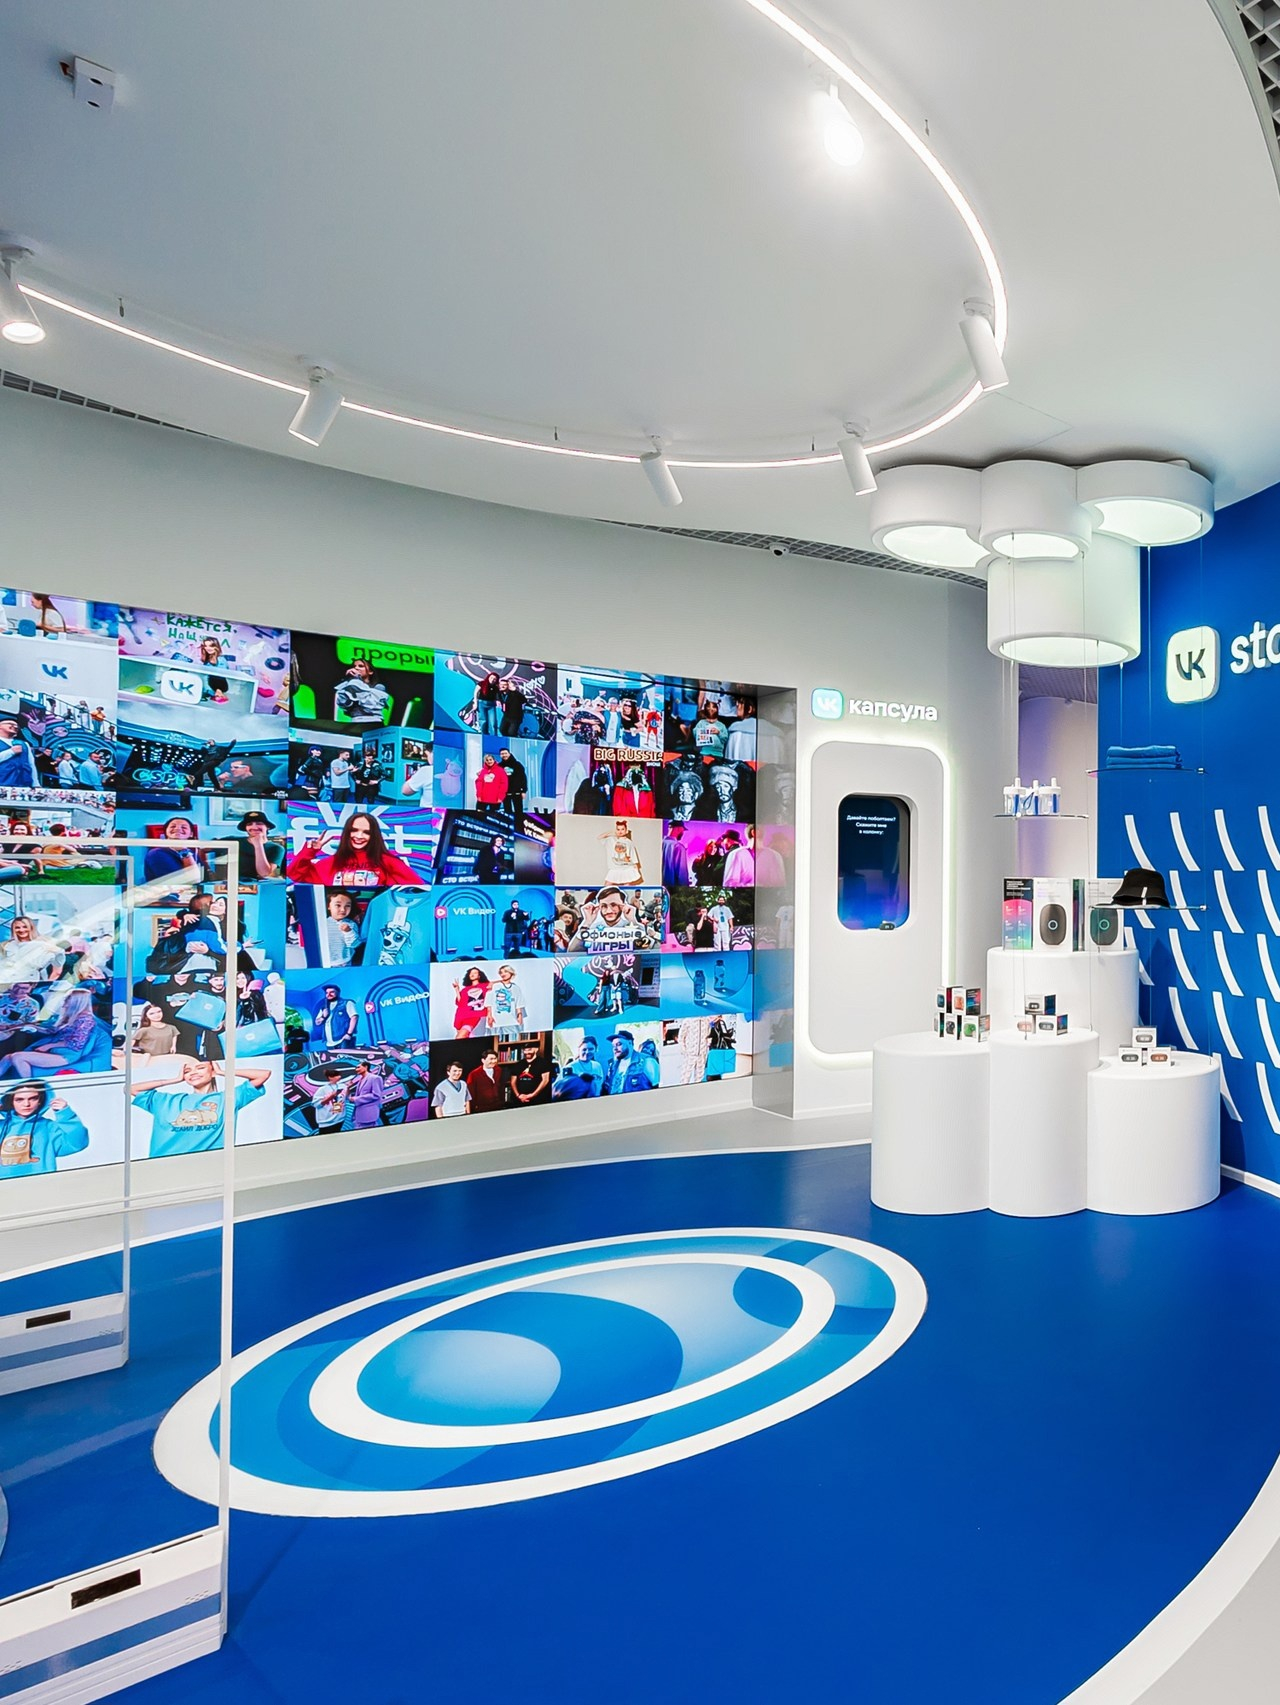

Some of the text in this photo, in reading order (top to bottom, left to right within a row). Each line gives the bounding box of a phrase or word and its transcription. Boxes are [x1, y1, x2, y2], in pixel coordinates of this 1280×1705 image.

[41, 663, 68, 680] VK
[1175, 648, 1206, 681] VK
[169, 679, 195, 697] VK
[849, 699, 938, 723] капсула
[593, 748, 616, 761] BIG
[453, 907, 497, 916] VK Видео
[394, 991, 430, 1005] Видео
